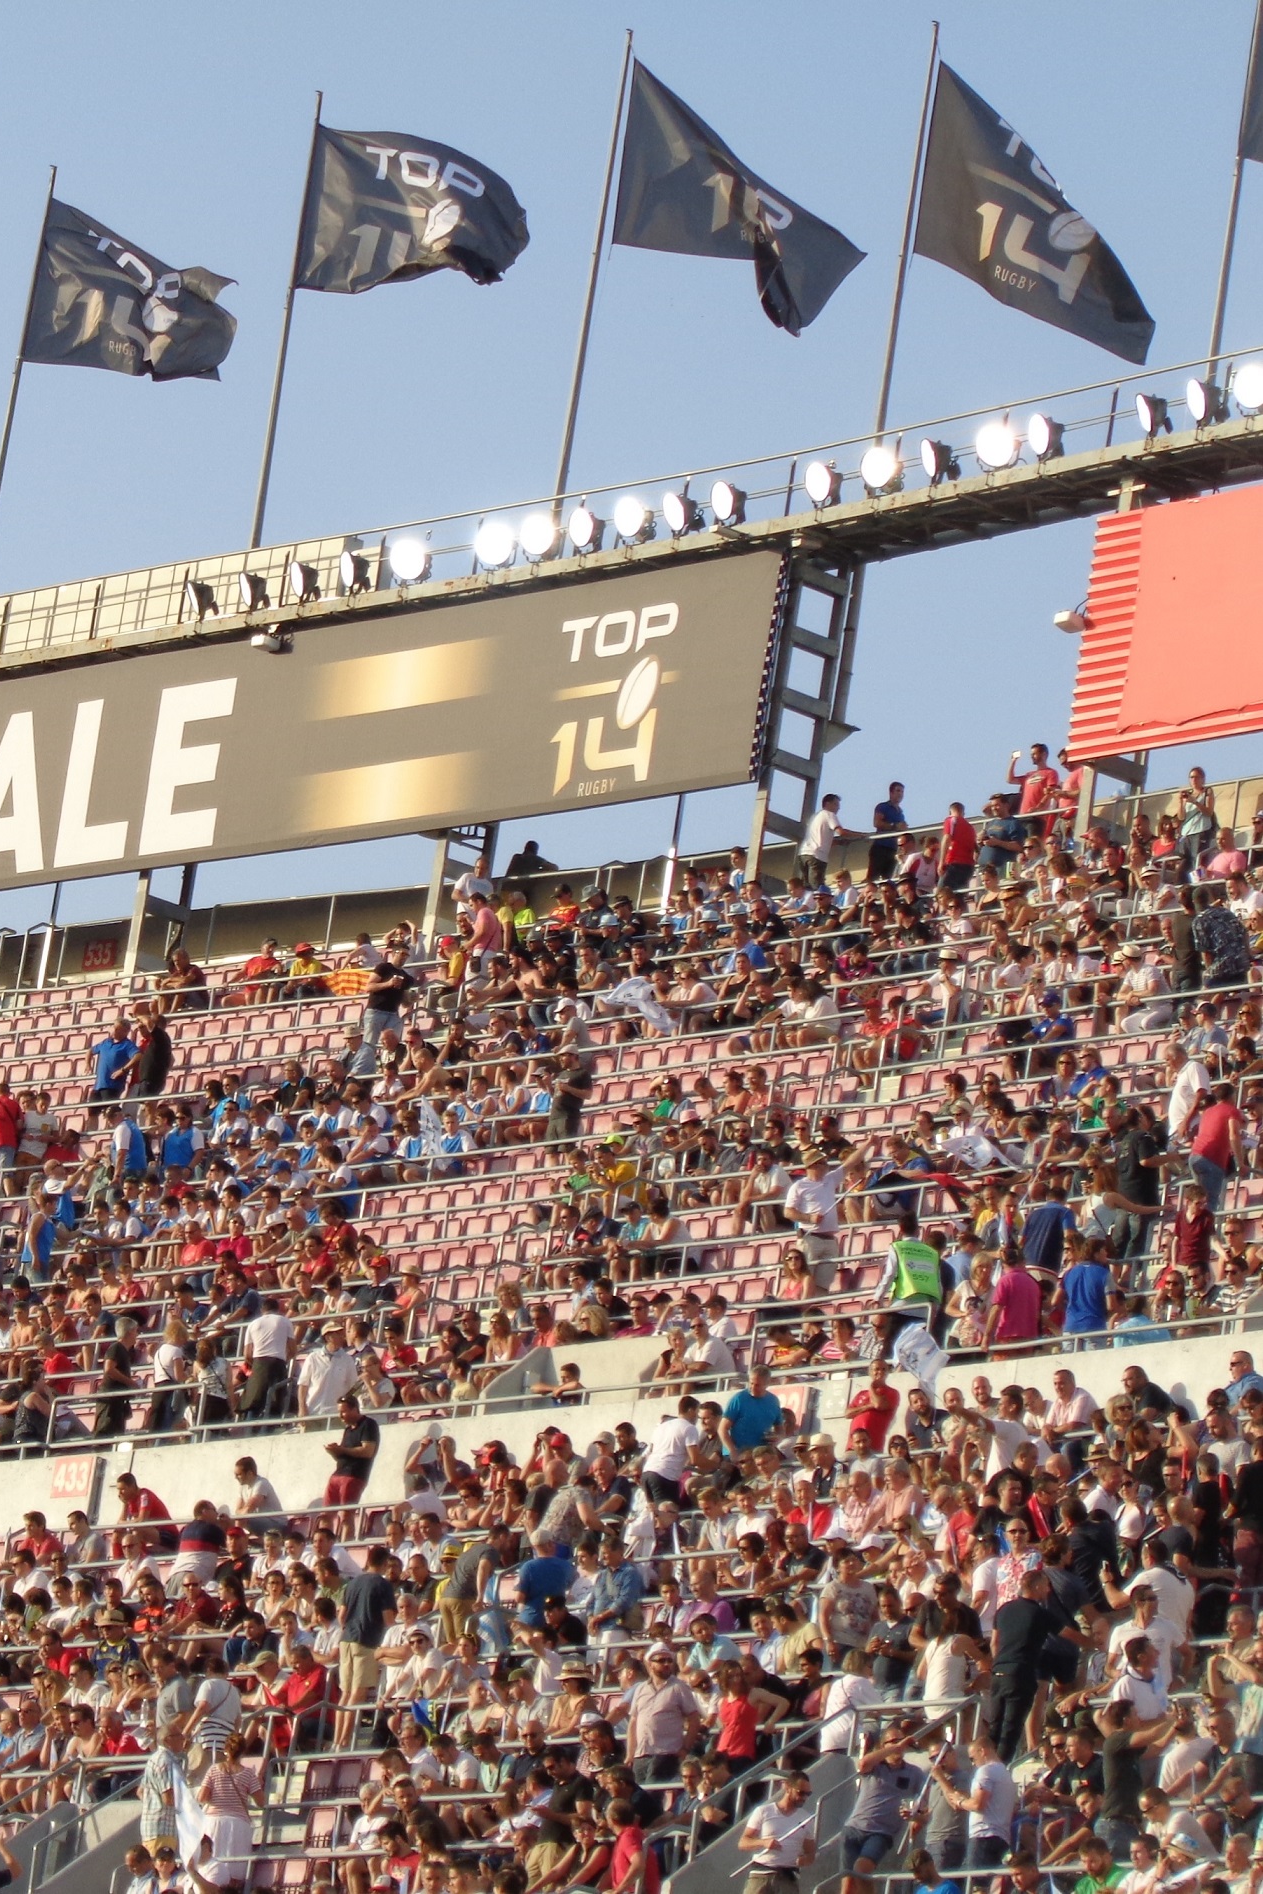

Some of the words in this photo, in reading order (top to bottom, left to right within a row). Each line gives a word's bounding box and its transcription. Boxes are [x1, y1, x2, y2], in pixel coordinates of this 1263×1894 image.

[366, 145, 486, 197] TOP
[976, 201, 1091, 305] 14
[994, 264, 1038, 293] RUGBY
[562, 602, 680, 663] TOP
[549, 707, 658, 797] 14
[577, 777, 617, 797] RUGBY
[84, 941, 113, 967] 535
[53, 1461, 90, 1493] 433
